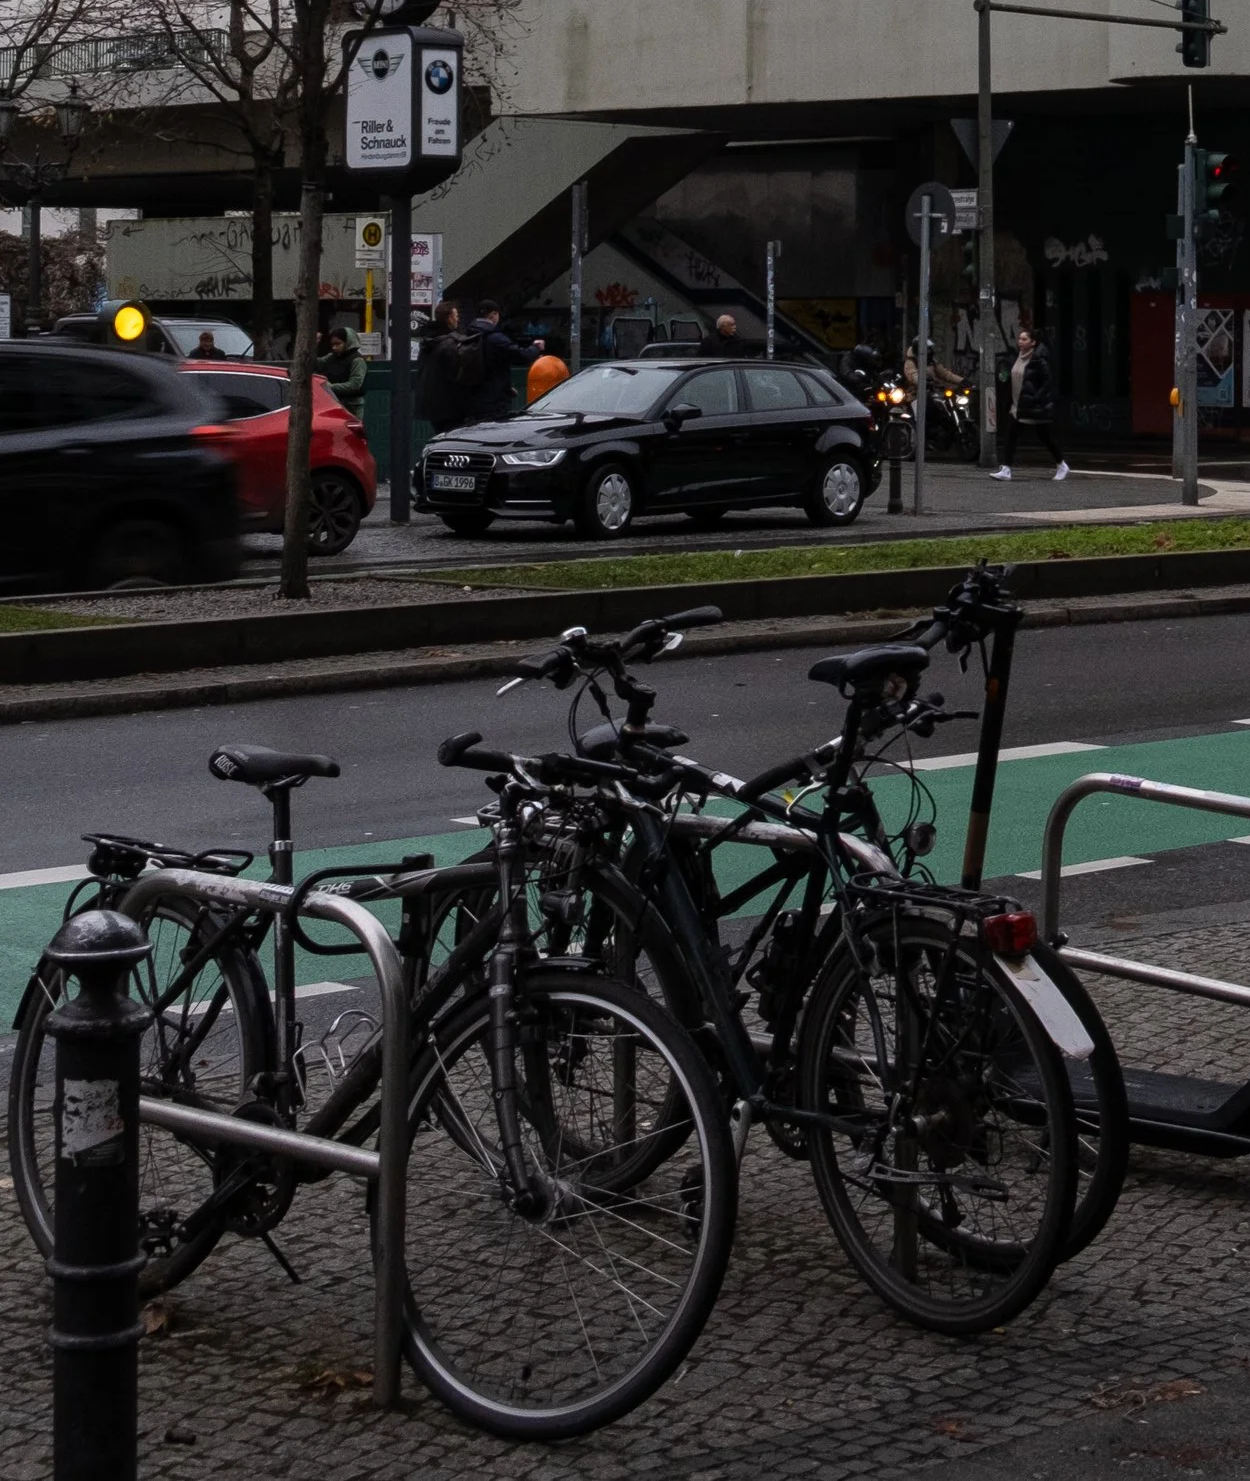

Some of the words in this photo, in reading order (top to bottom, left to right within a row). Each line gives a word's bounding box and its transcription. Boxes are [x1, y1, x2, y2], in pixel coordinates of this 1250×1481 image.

[361, 120, 385, 134] Riller
[386, 119, 394, 133] &
[361, 134, 407, 150] Schnauck
